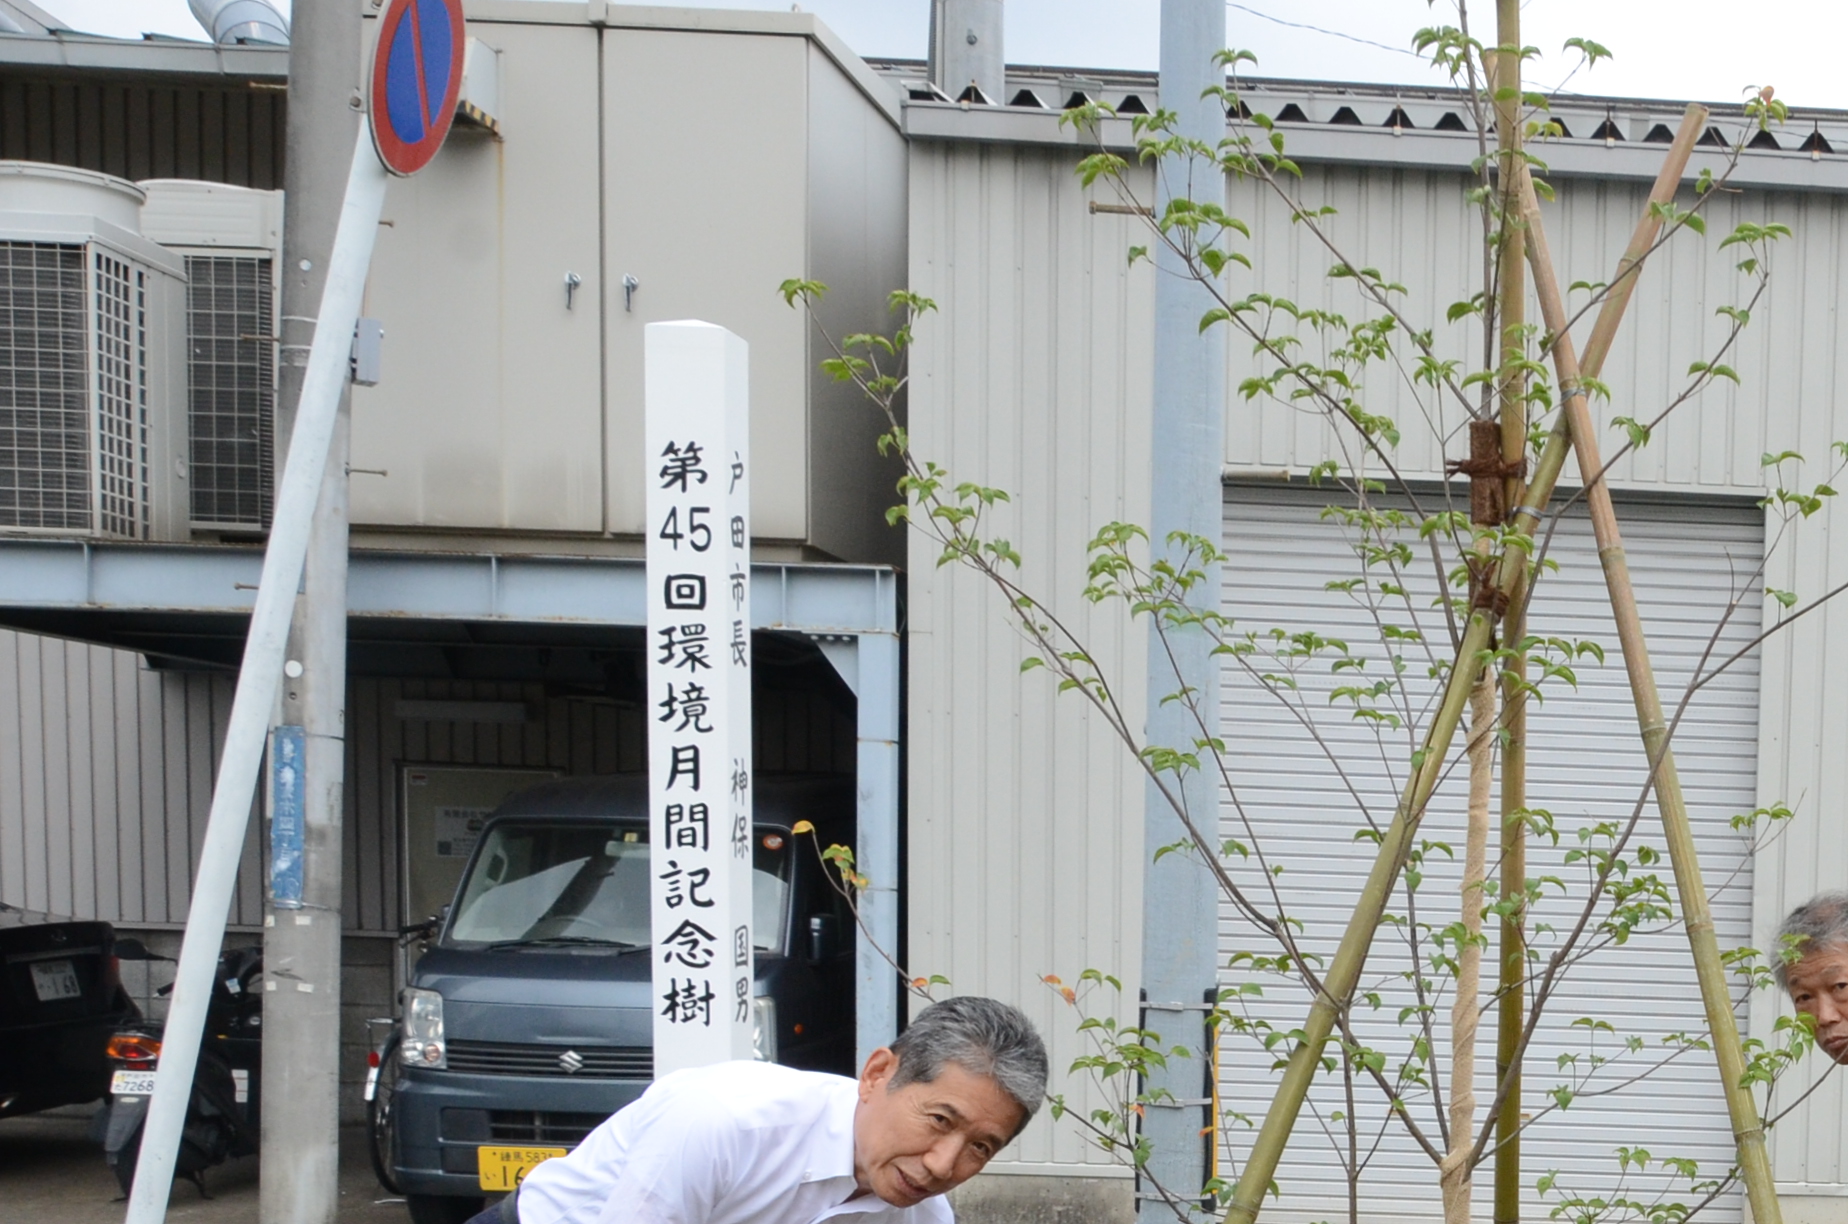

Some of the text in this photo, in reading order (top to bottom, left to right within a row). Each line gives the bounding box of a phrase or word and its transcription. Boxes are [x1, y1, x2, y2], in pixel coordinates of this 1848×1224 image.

[729, 451, 748, 667] 戸田市長
[657, 440, 718, 1027] 第45回環境月間記念樹
[731, 758, 749, 860] 神保
[123, 1080, 154, 1091] 7268
